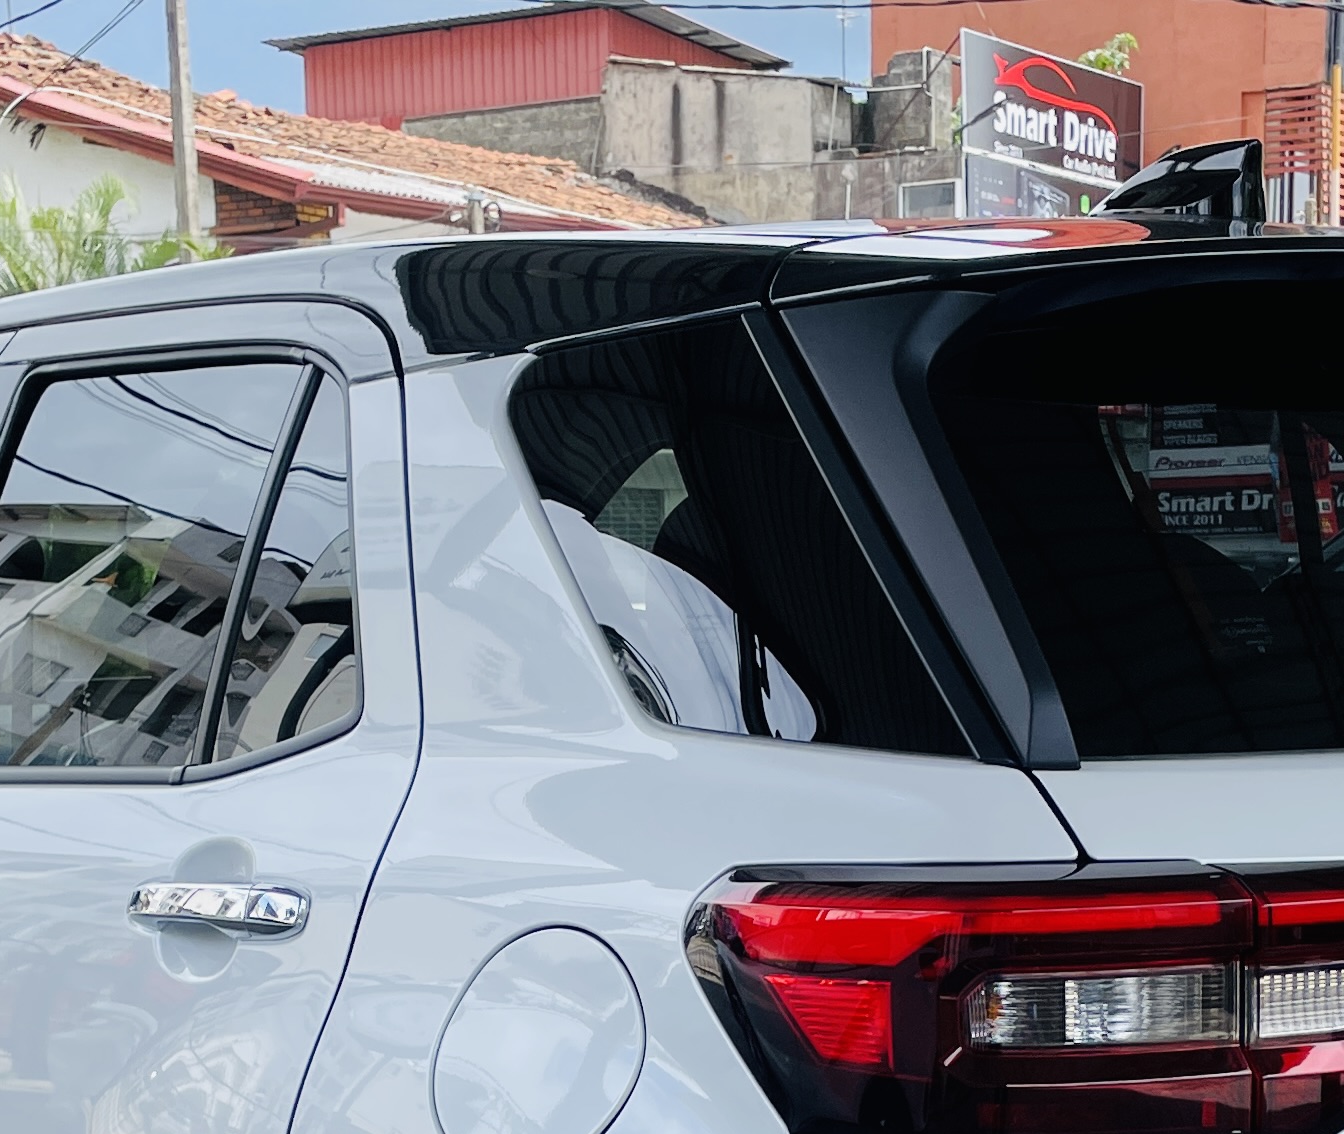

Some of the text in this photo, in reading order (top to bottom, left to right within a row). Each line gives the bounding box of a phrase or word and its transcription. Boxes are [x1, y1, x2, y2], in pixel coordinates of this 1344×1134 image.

[993, 90, 1117, 163] Smart Drive
[1158, 490, 1235, 513] Smart
